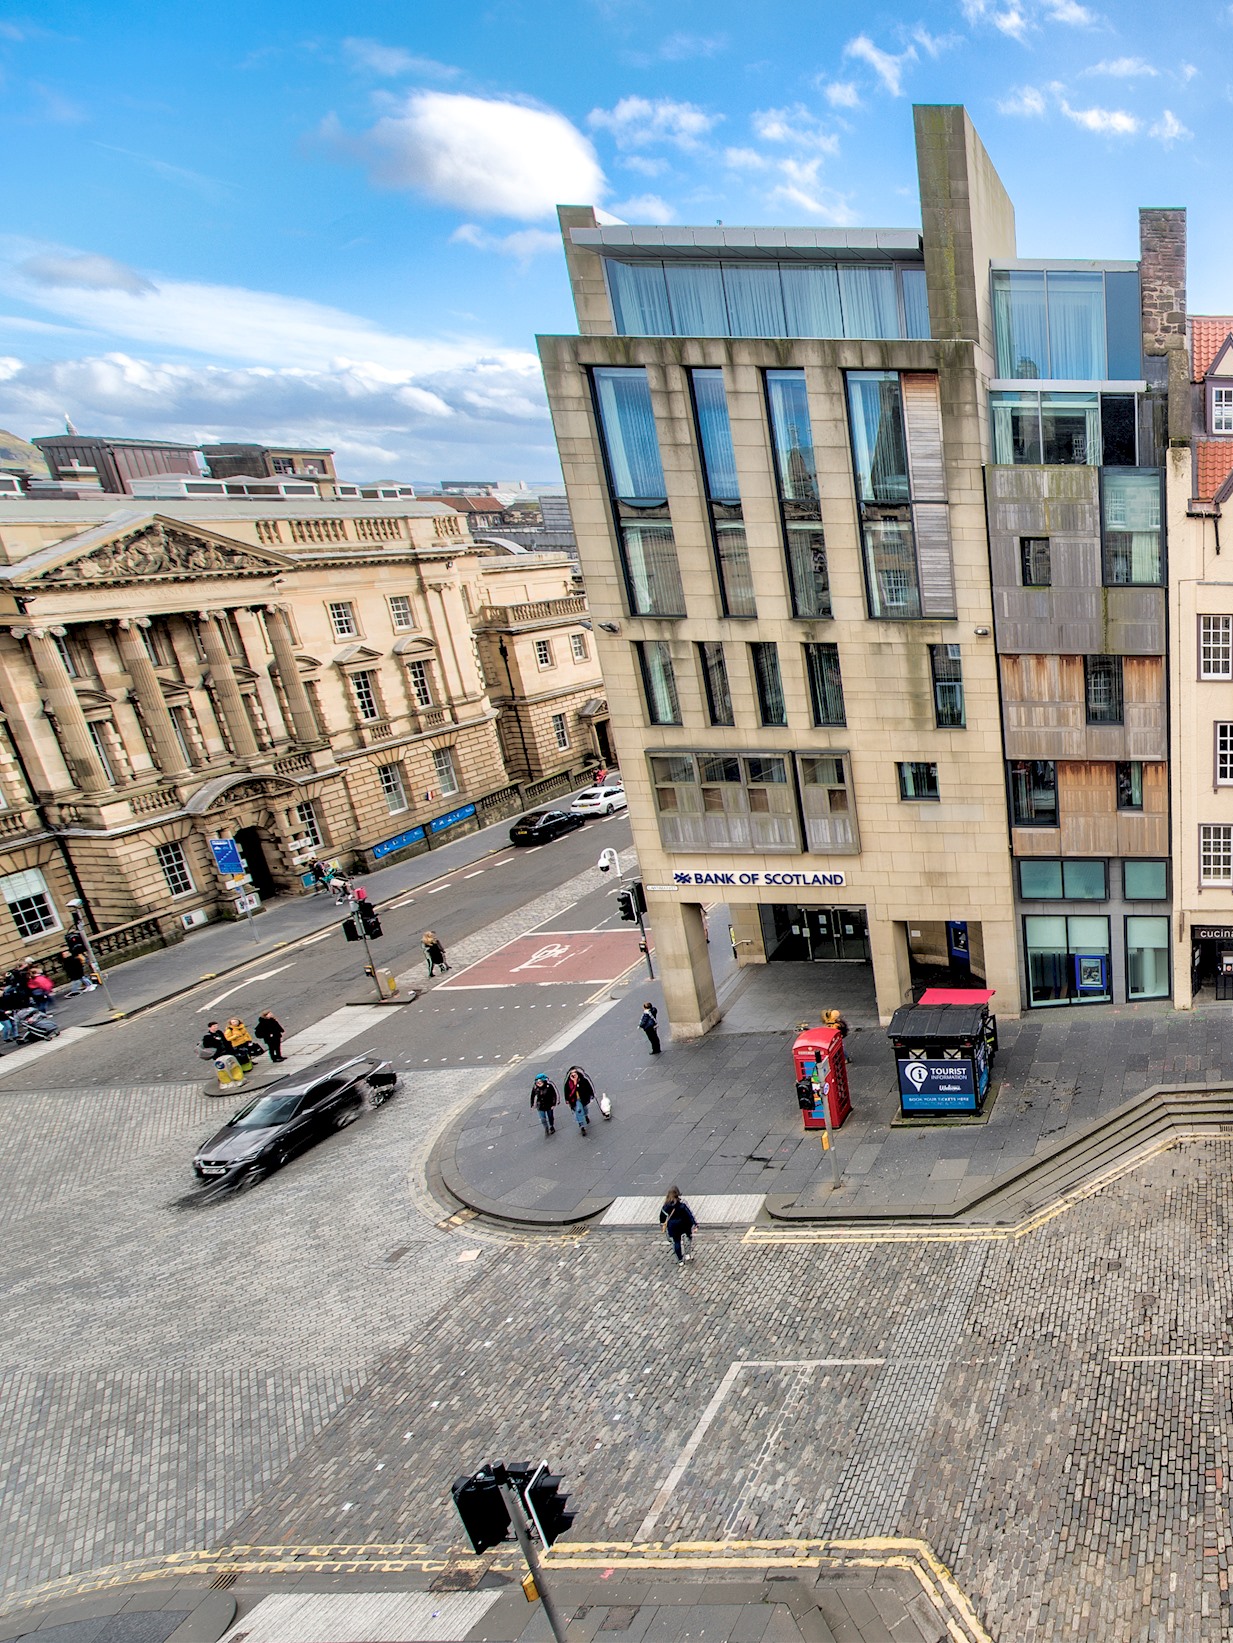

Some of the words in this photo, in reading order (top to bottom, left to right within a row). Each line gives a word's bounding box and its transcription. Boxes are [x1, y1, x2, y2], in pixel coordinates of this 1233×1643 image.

[694, 873, 736, 885] BANK
[738, 873, 759, 885] OF
[764, 873, 844, 886] SCOTLAND
